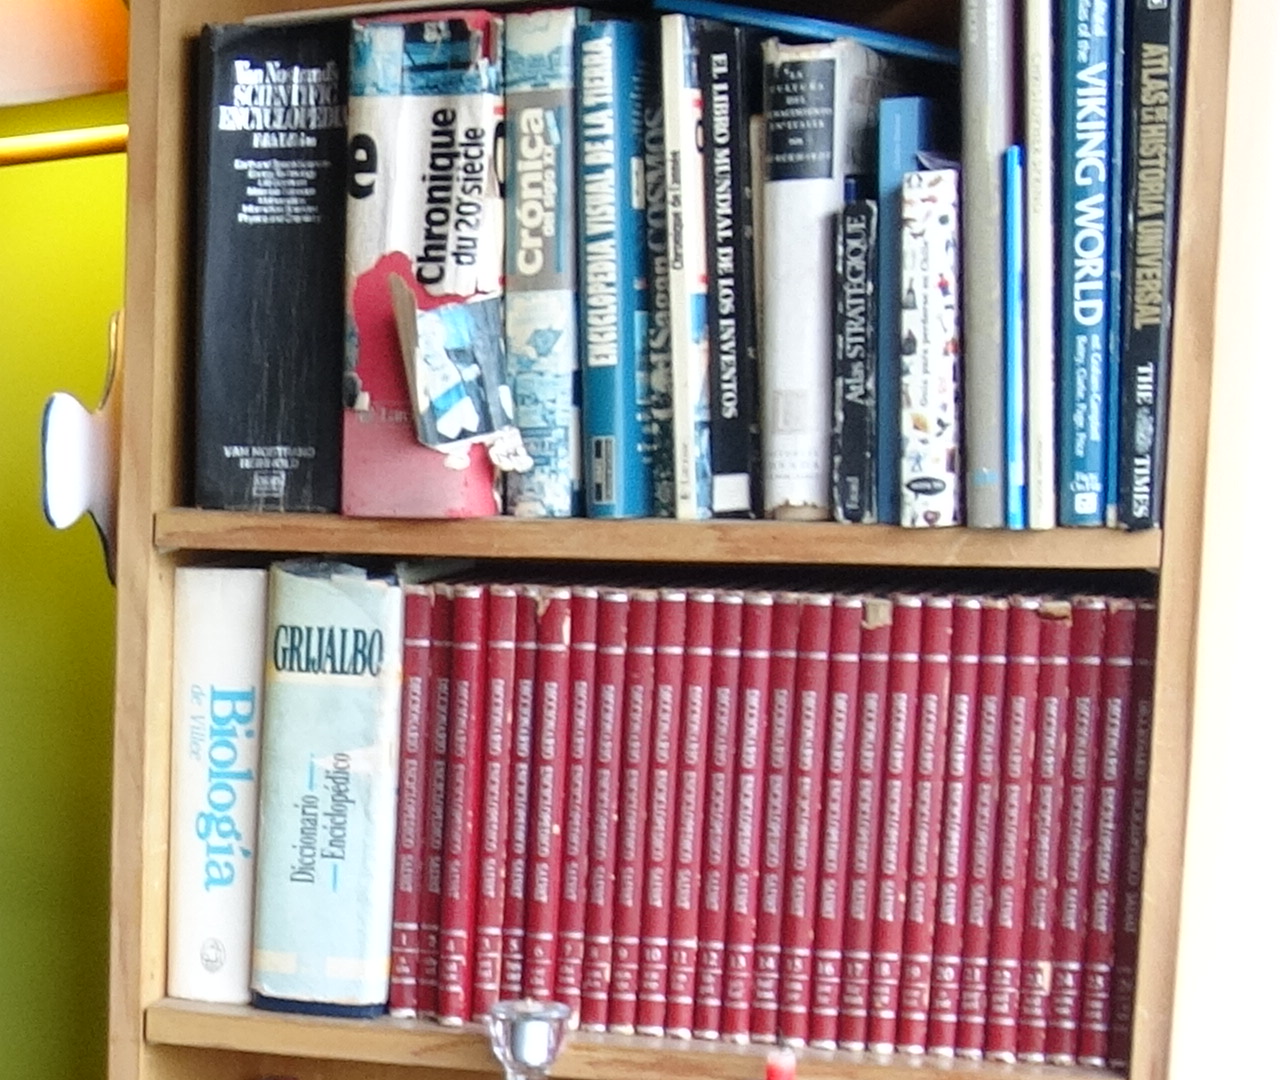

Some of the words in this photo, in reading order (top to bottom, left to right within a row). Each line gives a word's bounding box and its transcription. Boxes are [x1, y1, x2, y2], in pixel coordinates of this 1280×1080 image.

[233, 60, 264, 83] Van
[233, 83, 338, 107] SCIENTIFIC
[582, 37, 613, 108] TIERRA
[710, 53, 729, 80] EL
[1140, 43, 1169, 105] ATLAS
[583, 109, 615, 136] LA
[711, 82, 732, 145] LIBRO
[1074, 61, 1107, 187] VIKING
[457, 127, 485, 197] siècle
[584, 139, 617, 165] DE
[644, 106, 668, 254] COSMOS
[1137, 122, 1167, 214] HISTORIA
[415, 108, 459, 286] Chronique
[543, 211, 556, 237] del
[584, 167, 618, 234] VISUAL
[712, 147, 734, 243] MUNDIAL
[451, 236, 478, 266] du
[715, 246, 734, 275] DE
[1073, 195, 1106, 326] WORLD
[1134, 220, 1164, 329] UNIVERSAL
[586, 238, 619, 367] ENCICLOPEDIA
[716, 277, 736, 315] LOS
[718, 319, 739, 419] INVENTOS
[1135, 362, 1154, 405] THE
[1132, 454, 1152, 518] TIMES
[273, 625, 385, 677] GRIJALBO
[195, 685, 256, 892] Biología
[320, 751, 355, 861] Enciclopédico
[290, 793, 320, 885] Diccionario
